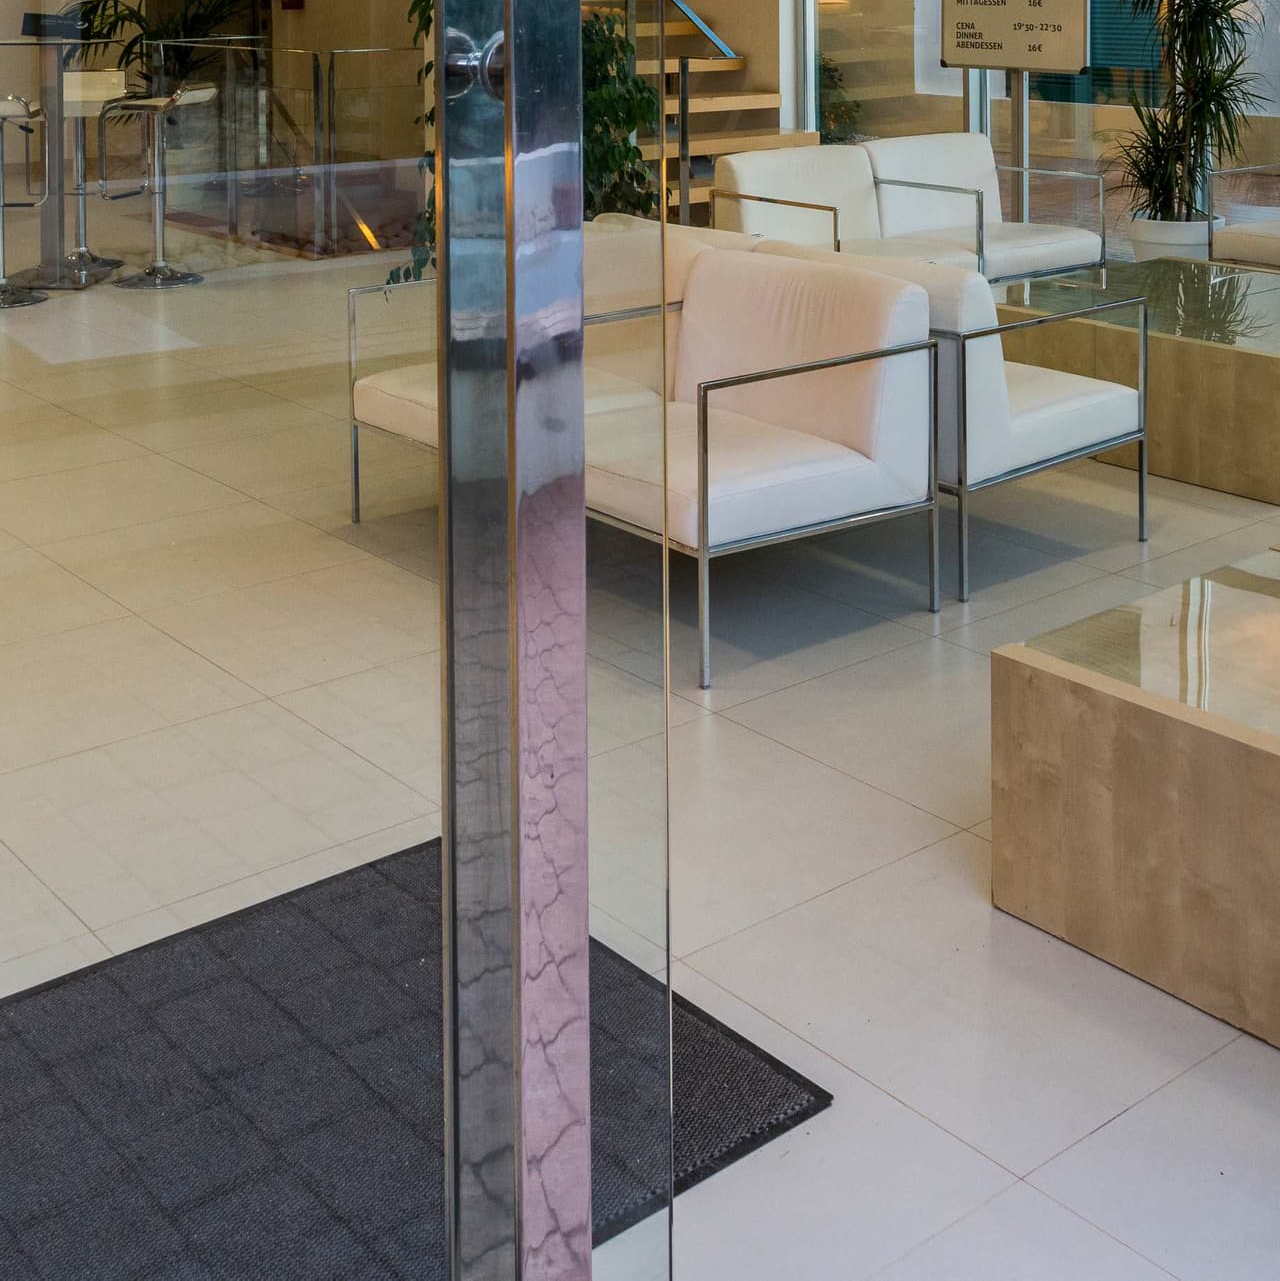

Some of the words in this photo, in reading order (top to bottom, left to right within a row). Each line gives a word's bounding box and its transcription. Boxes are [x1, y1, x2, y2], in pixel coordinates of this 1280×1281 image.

[956, 22, 975, 30] CENA
[956, 31, 983, 40] DINNER
[956, 41, 1003, 50] ABENDESSEN
